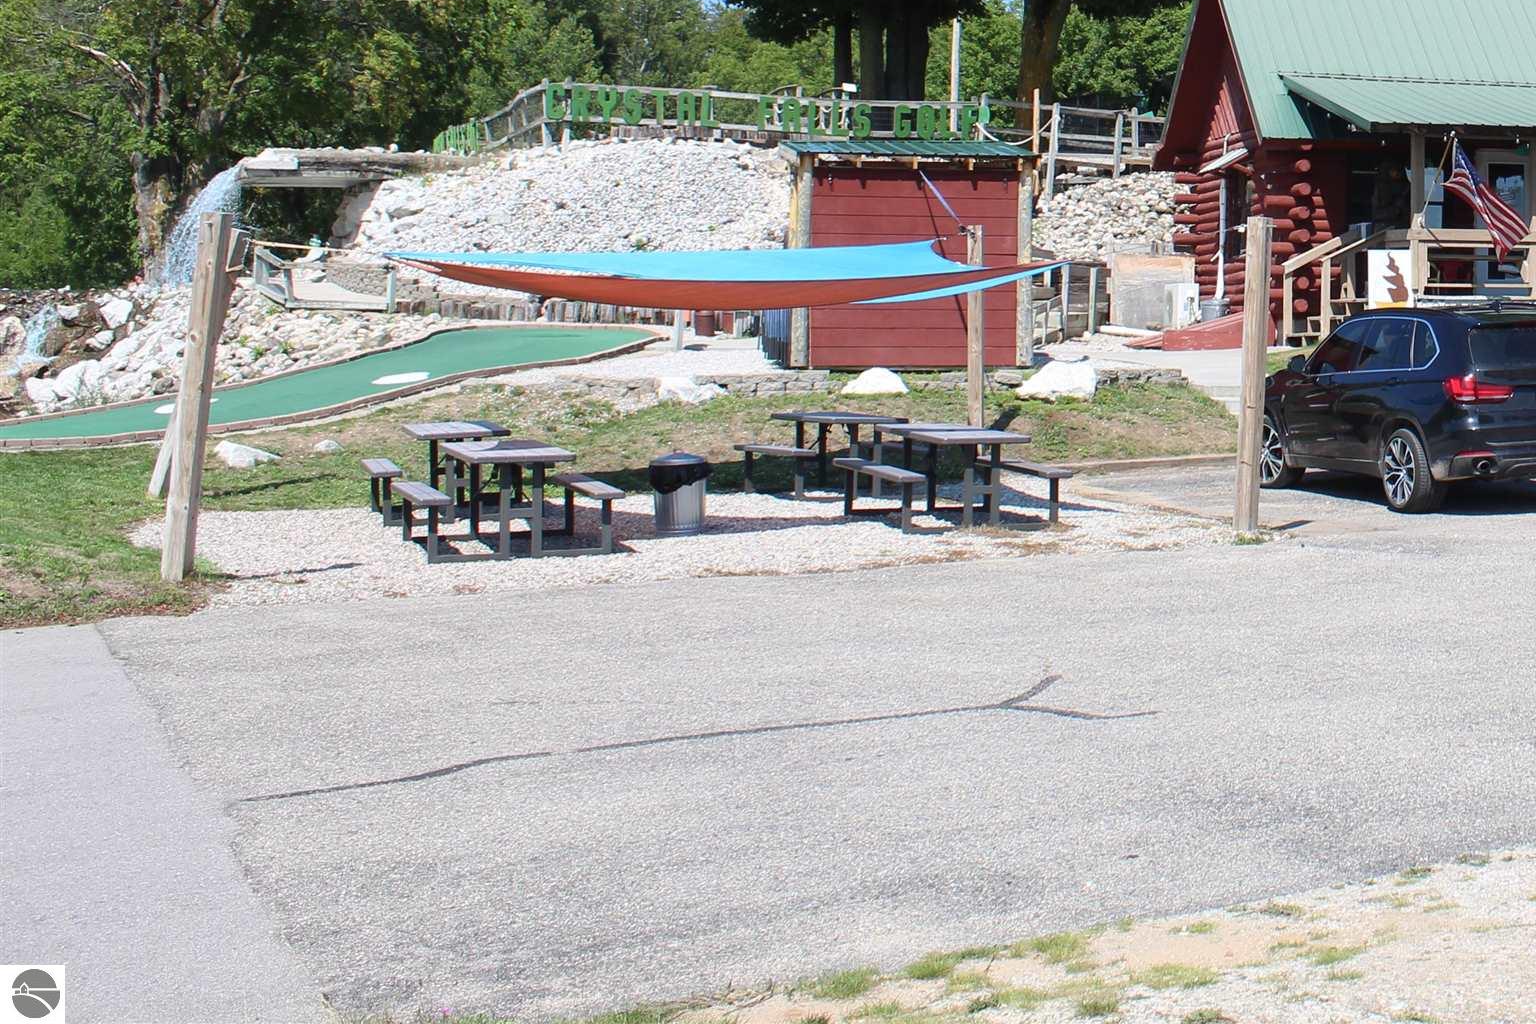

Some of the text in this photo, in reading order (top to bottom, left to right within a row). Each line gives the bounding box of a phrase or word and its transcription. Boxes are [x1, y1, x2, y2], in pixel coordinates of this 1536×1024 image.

[545, 83, 978, 141] CRYSTAL FALLS GOLF
